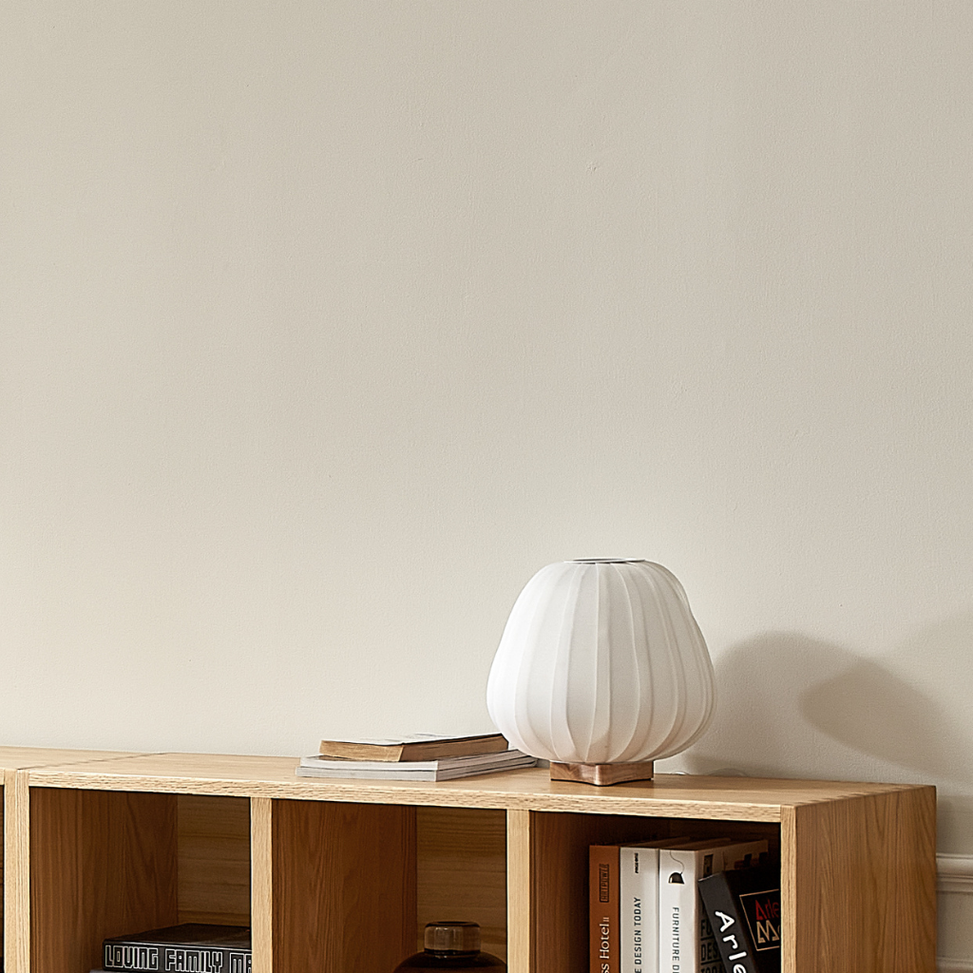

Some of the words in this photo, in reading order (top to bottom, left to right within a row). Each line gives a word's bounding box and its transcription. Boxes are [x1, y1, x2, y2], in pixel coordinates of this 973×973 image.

[633, 897, 641, 927] TODAY
[599, 923, 610, 959] Hotel
[634, 929, 643, 965] DESIGN
[671, 907, 680, 962] FURNITURE
